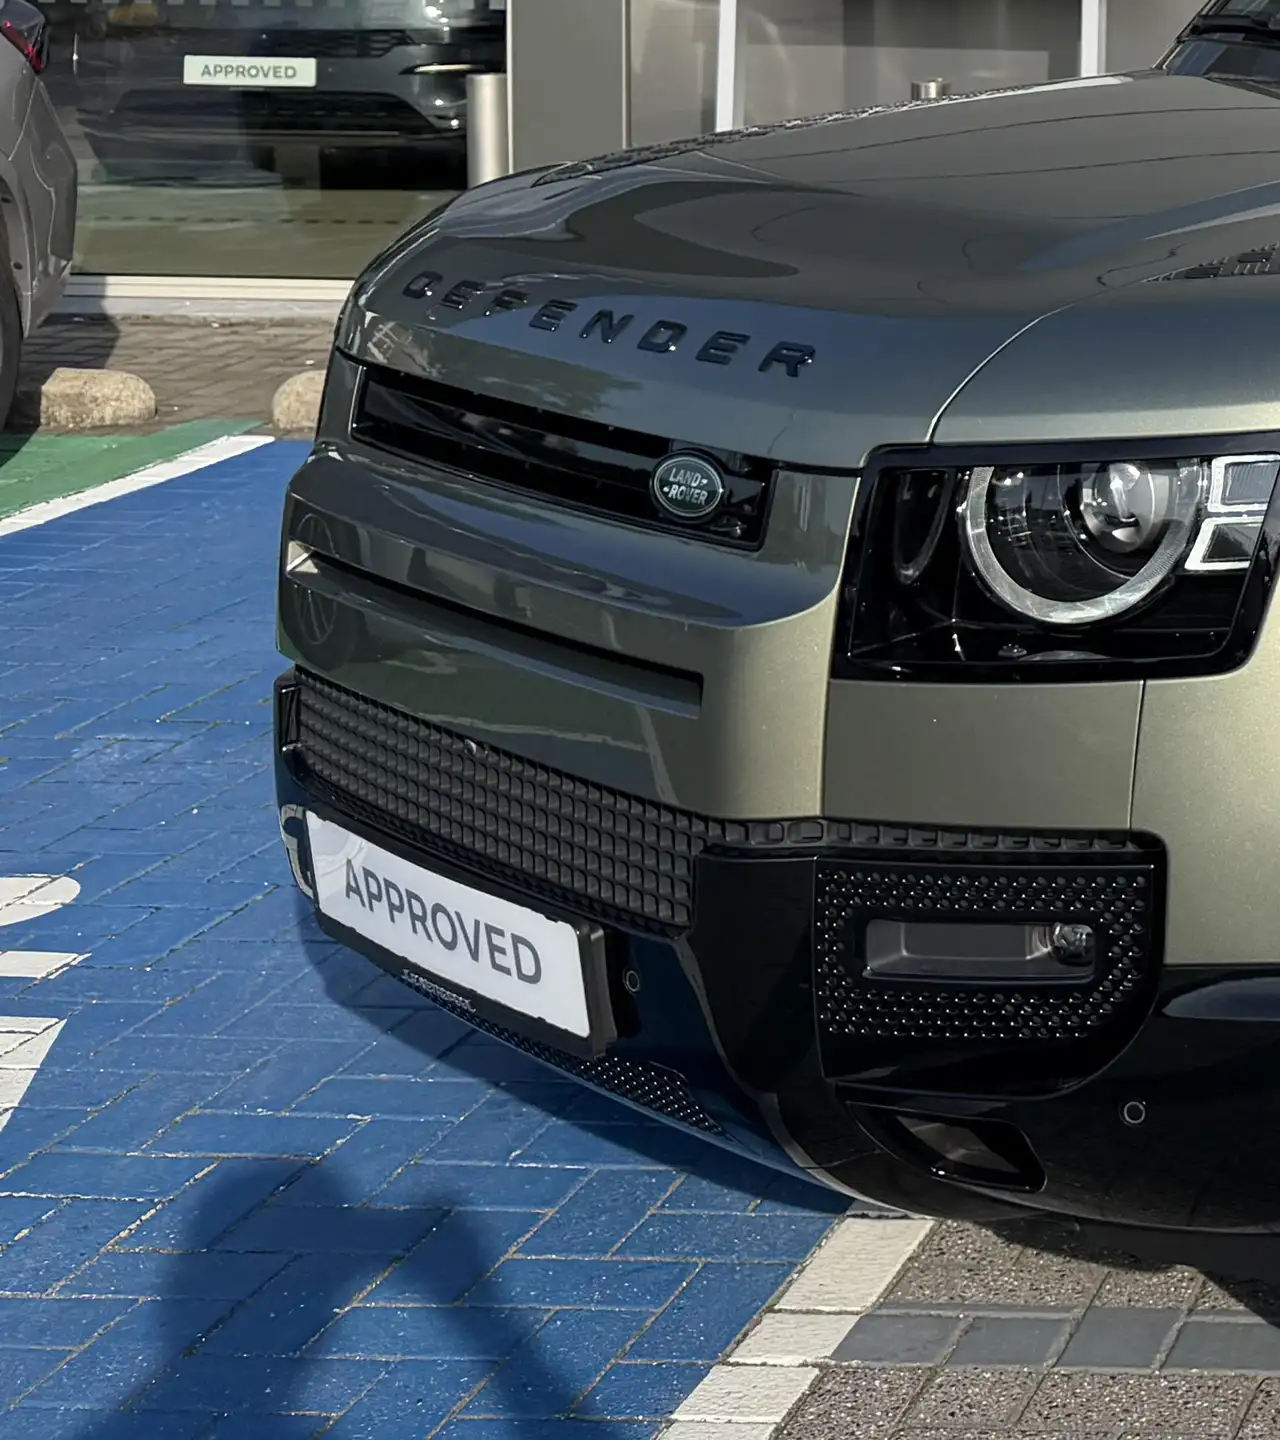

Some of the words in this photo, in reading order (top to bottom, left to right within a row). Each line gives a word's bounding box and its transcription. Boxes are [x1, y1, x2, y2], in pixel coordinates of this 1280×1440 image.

[200, 63, 298, 79] APPROVED
[402, 270, 817, 378] DEFENDER
[668, 467, 702, 487] LAND
[667, 484, 709, 506] ROVER
[344, 857, 543, 986] APPROVED
